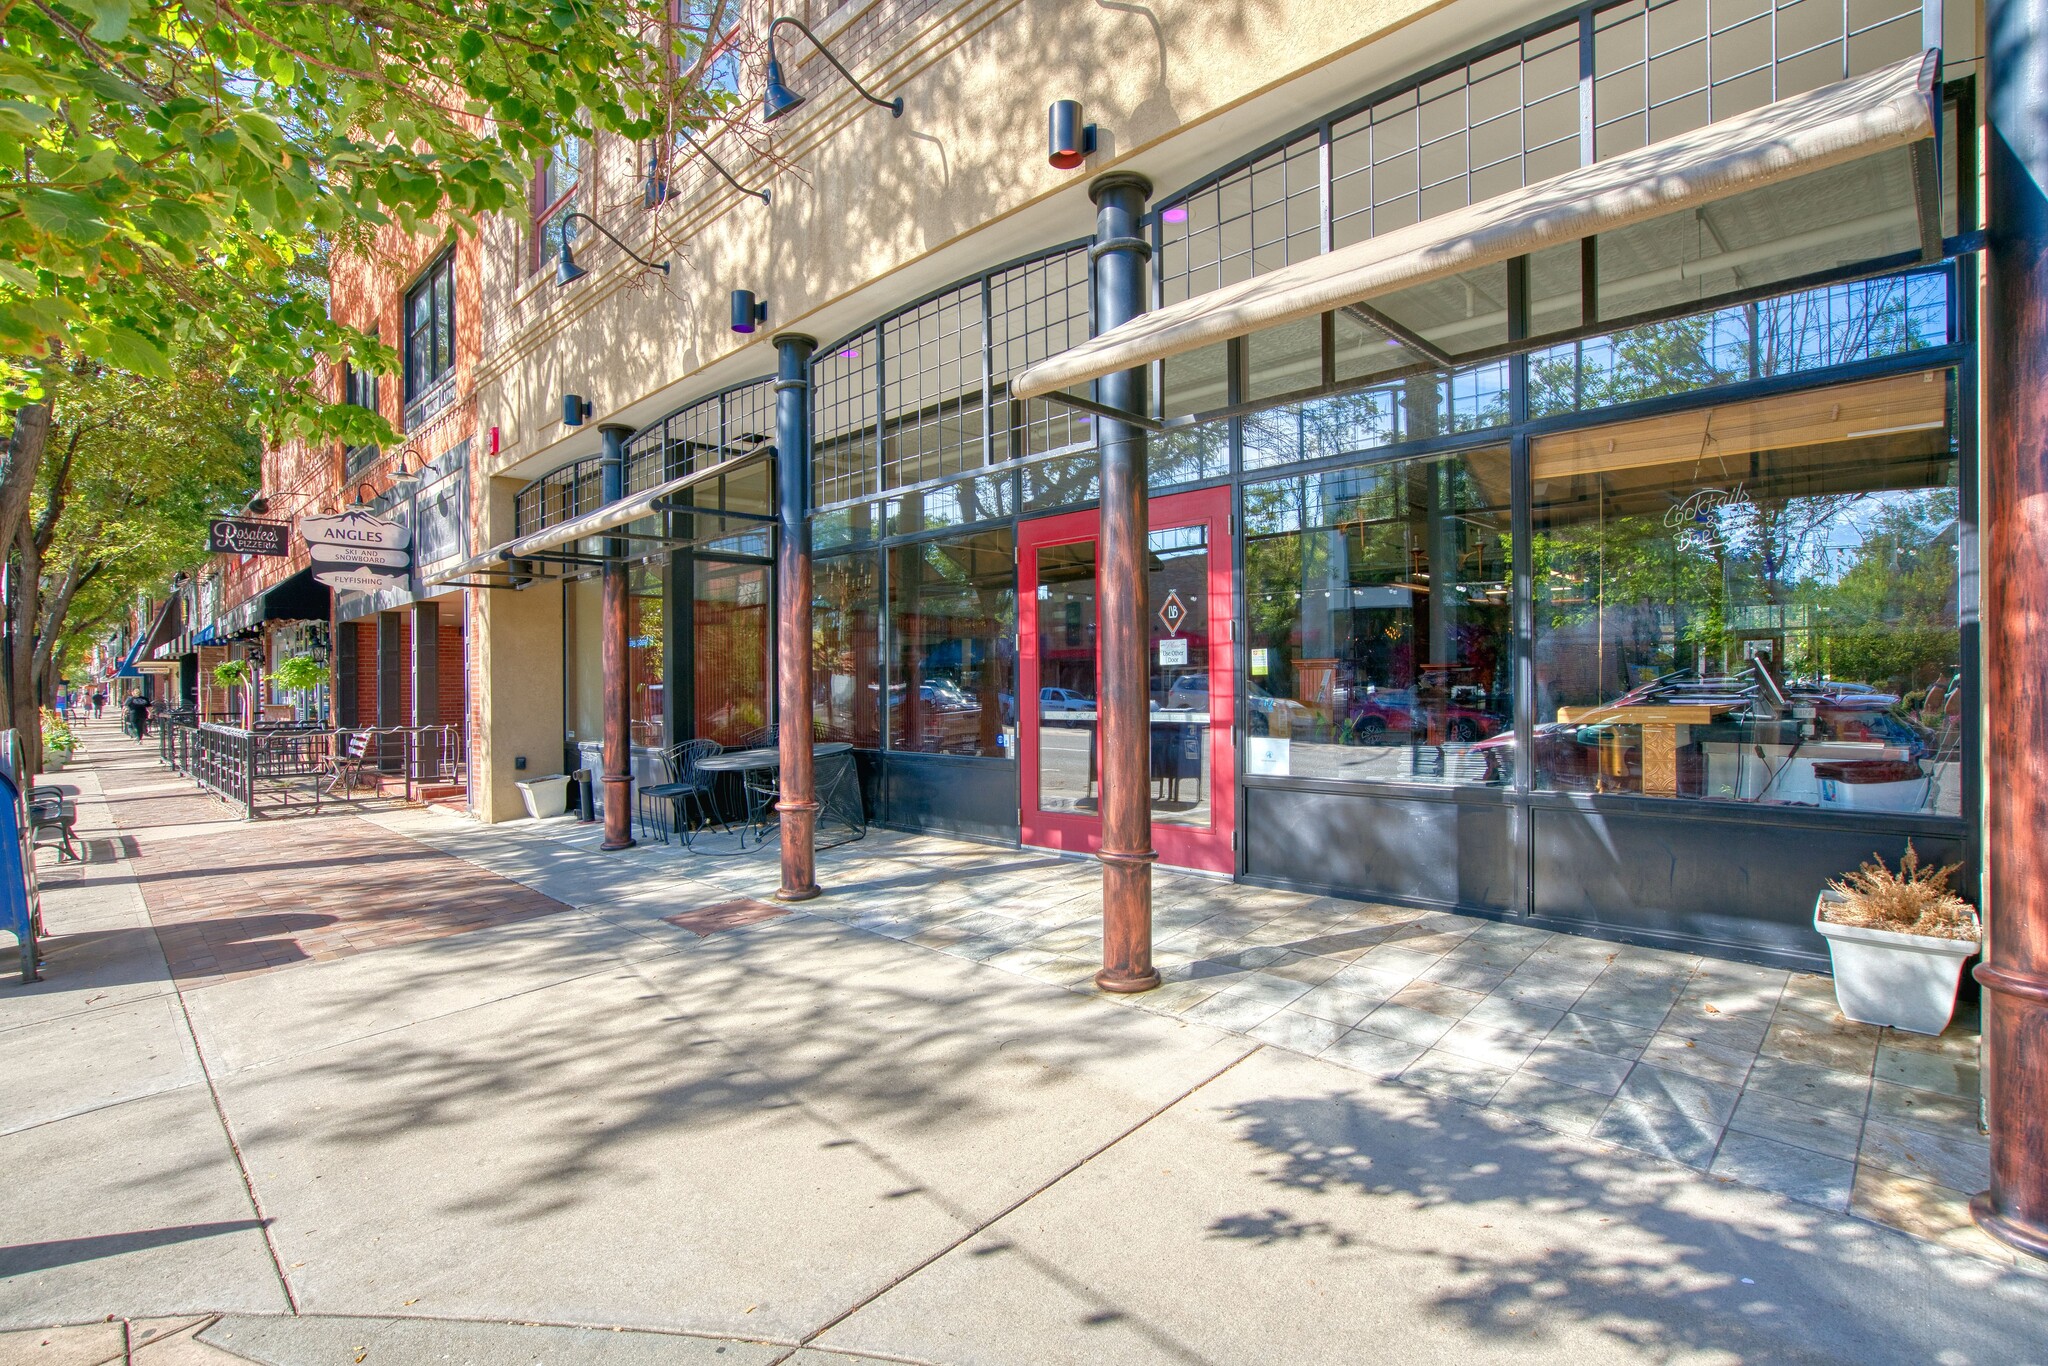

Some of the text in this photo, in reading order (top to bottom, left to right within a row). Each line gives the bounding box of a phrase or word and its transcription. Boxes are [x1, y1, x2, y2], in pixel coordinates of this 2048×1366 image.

[1663, 481, 1750, 528] Cocktails
[213, 522, 279, 552] Rosalee's
[323, 528, 383, 543] ANGLES
[238, 540, 278, 550] PIZZERIA
[335, 554, 386, 564] SNOWBOARD
[334, 576, 383, 586] FLYFISHING
